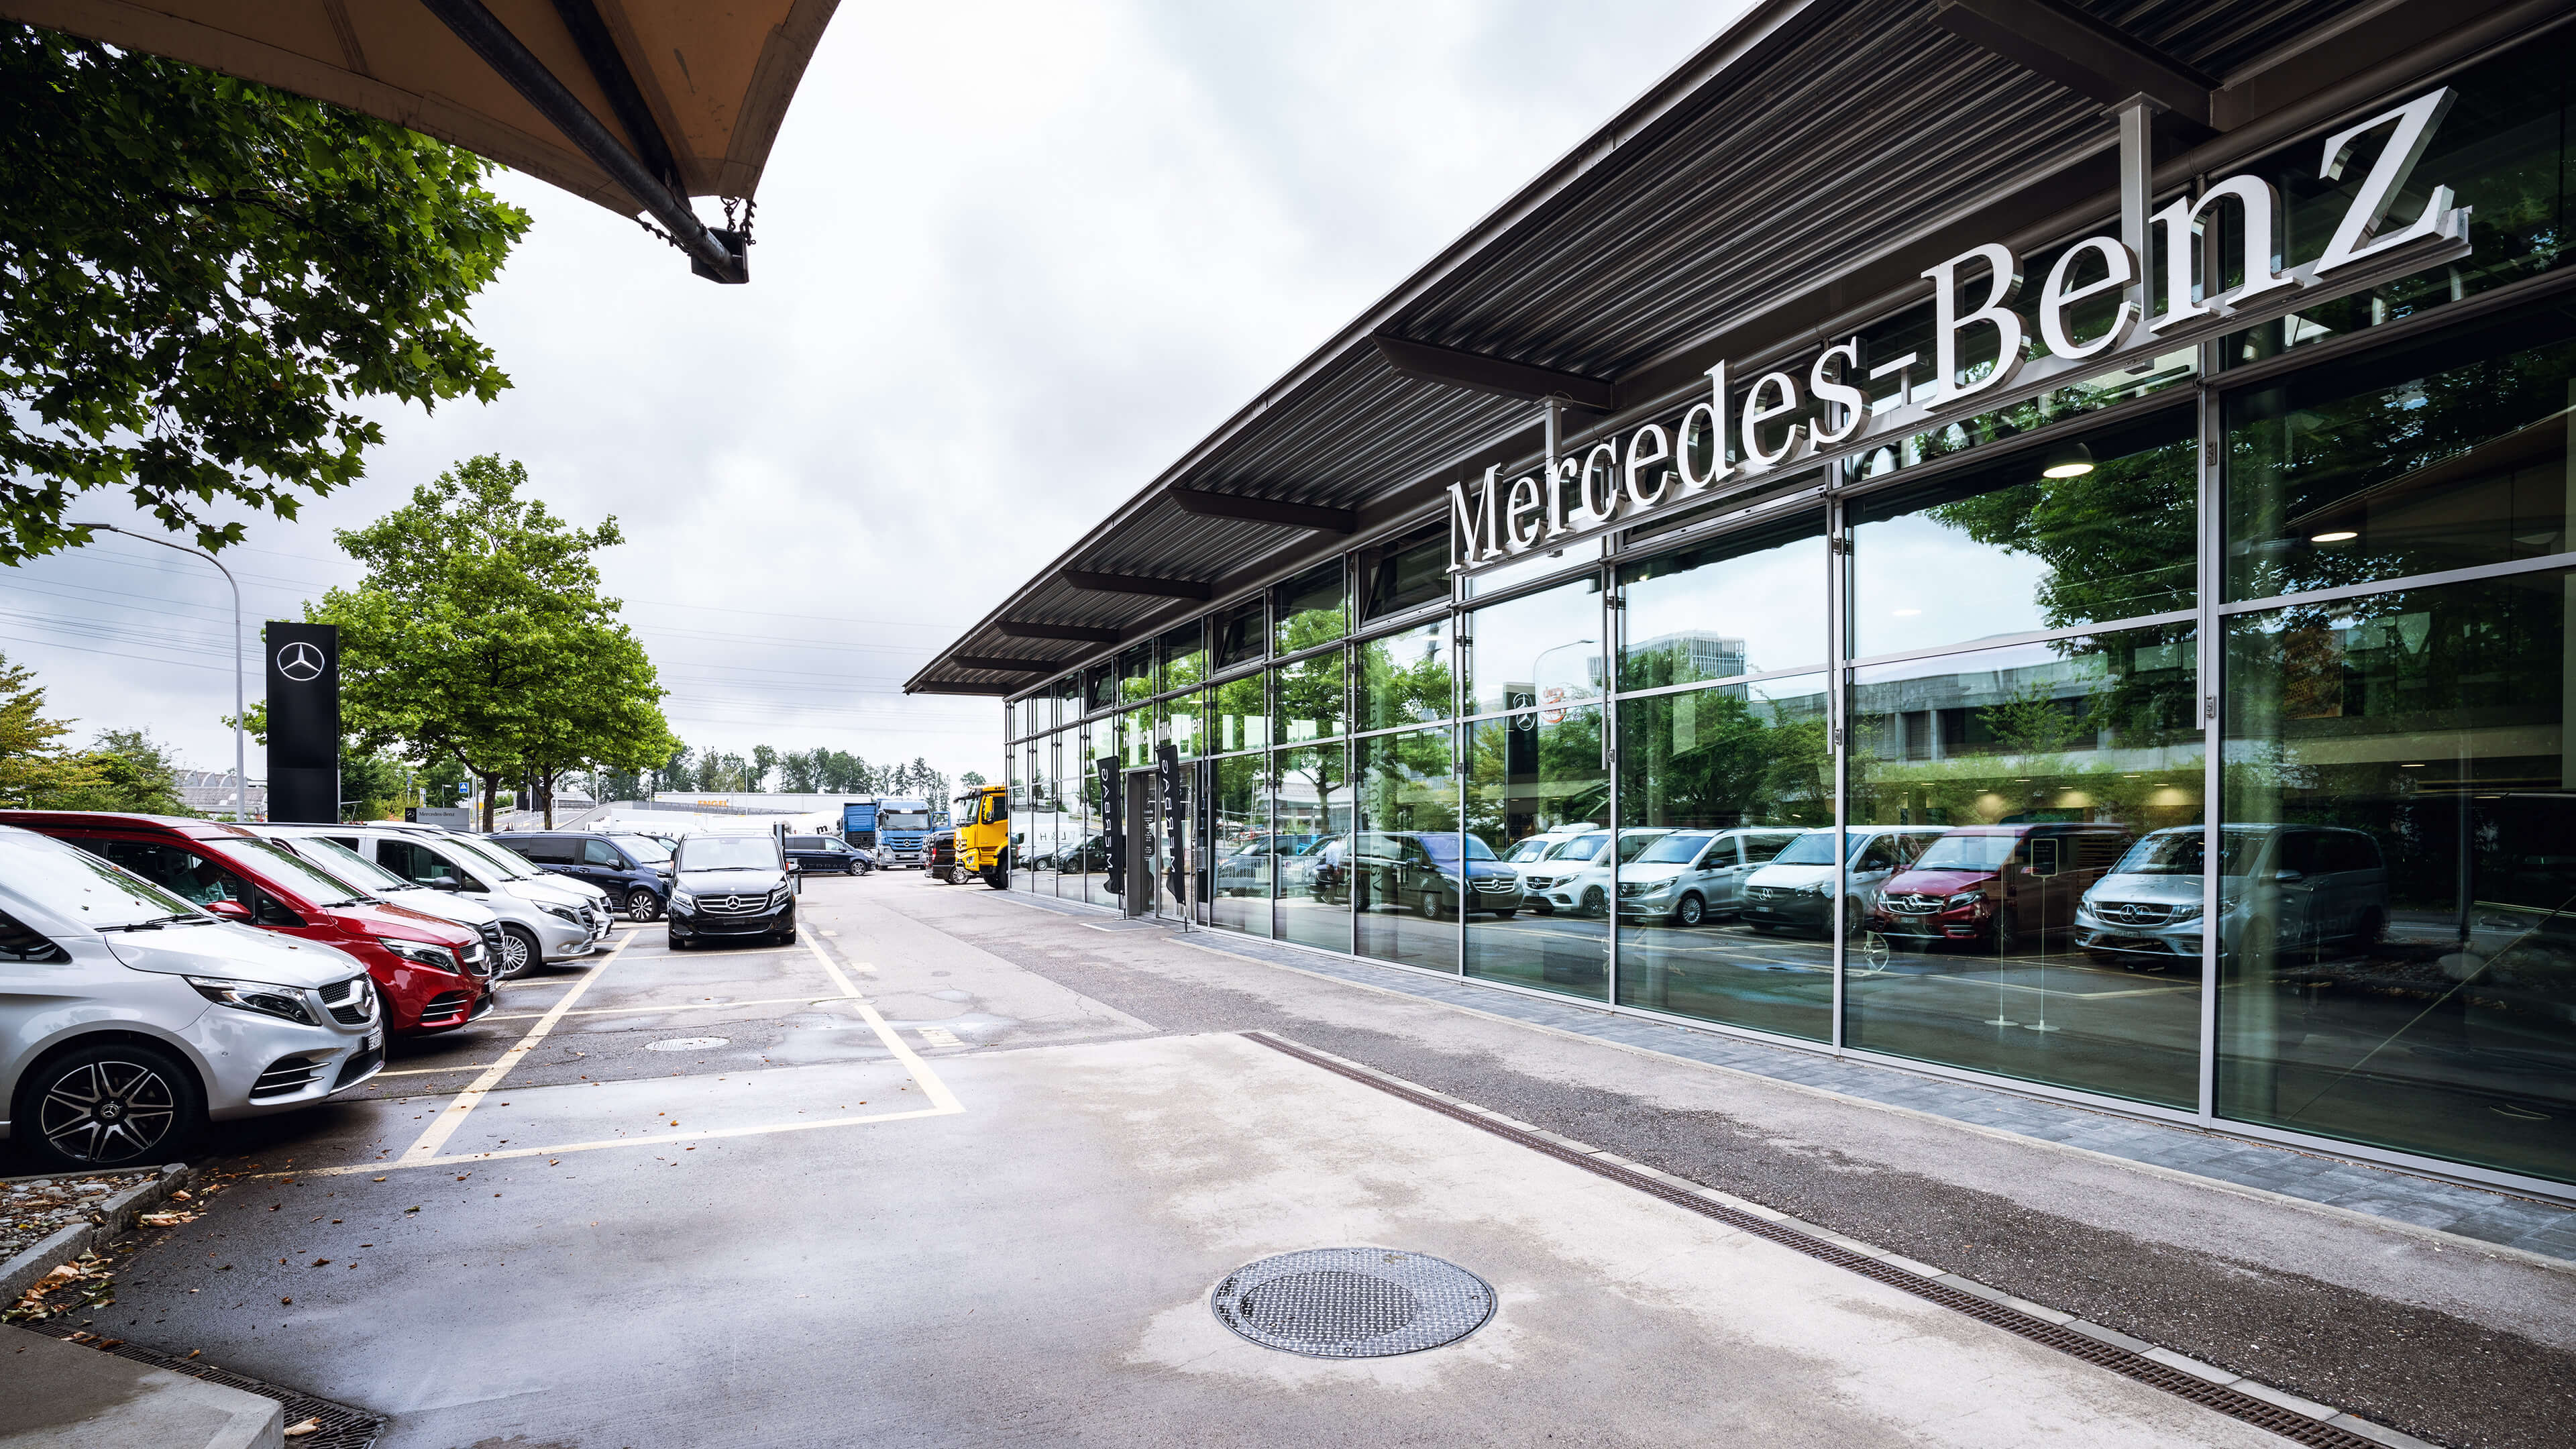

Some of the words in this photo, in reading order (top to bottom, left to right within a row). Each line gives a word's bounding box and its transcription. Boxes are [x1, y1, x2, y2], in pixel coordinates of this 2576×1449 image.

[1445, 87, 2459, 574] Mercedes-Benz
[1123, 726, 1152, 748] Helic
[1155, 718, 1203, 746] illken
